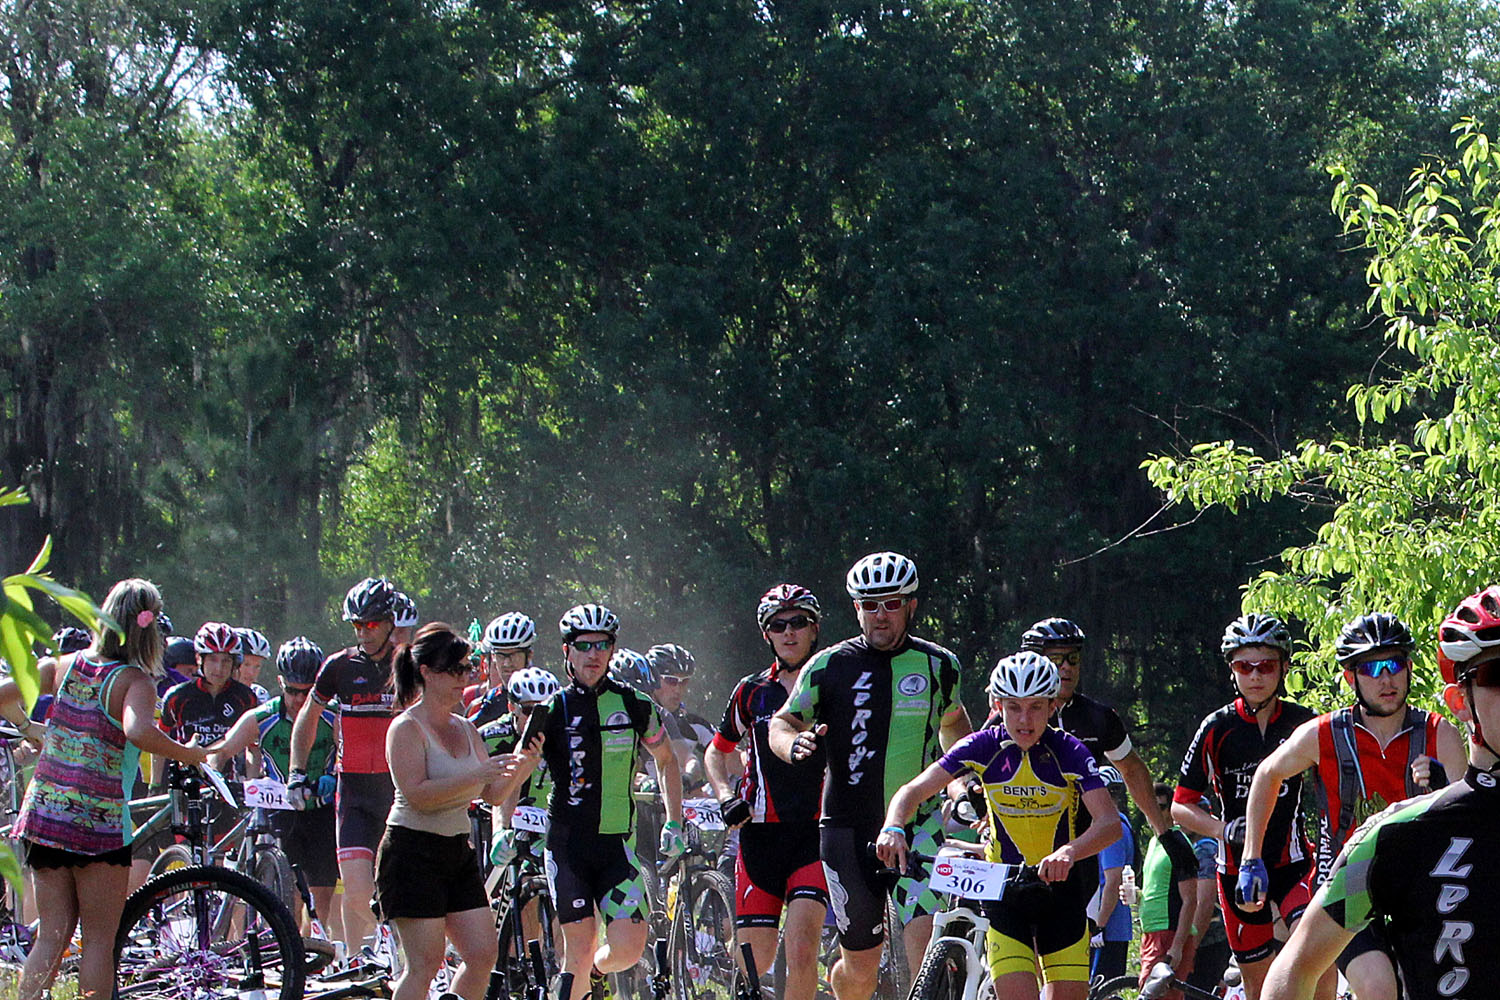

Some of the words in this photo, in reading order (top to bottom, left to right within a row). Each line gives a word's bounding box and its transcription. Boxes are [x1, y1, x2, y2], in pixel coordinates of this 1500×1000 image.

[1004, 785, 1047, 796] BENT'S
[258, 792, 283, 805] 304
[937, 866, 952, 874] HOT
[946, 875, 986, 894] 306
